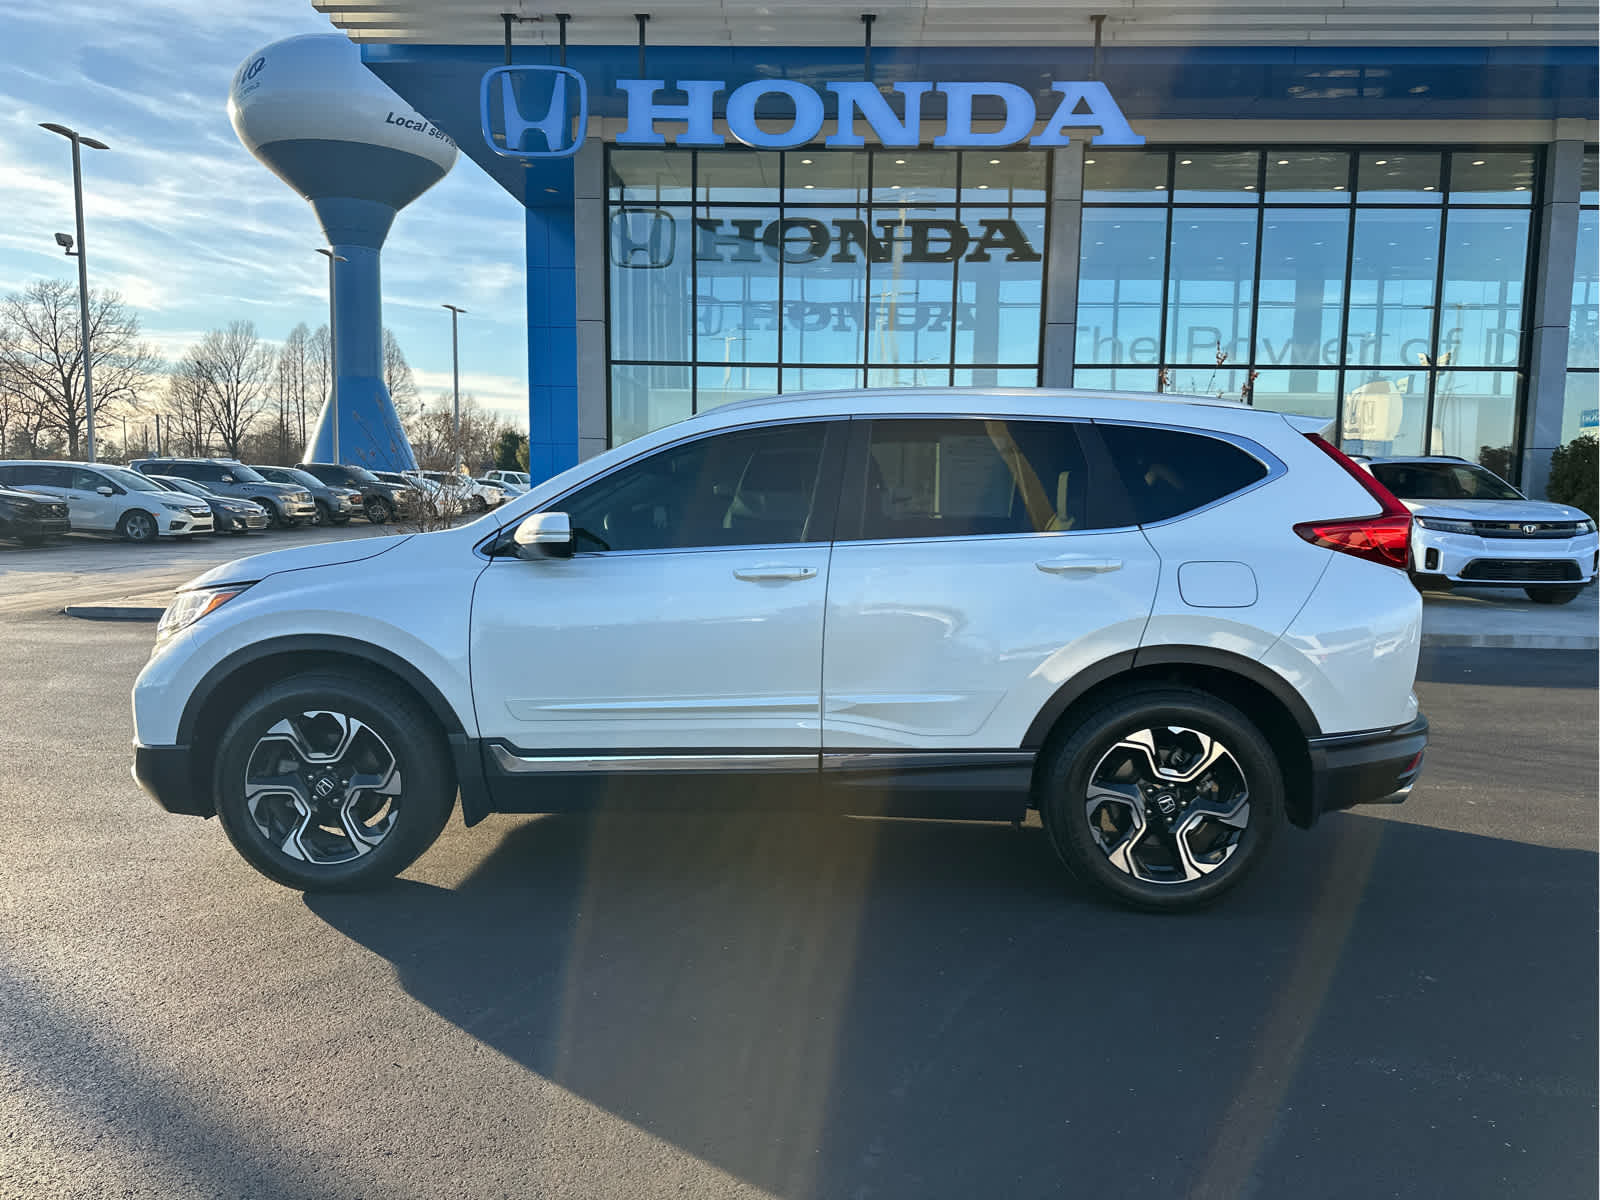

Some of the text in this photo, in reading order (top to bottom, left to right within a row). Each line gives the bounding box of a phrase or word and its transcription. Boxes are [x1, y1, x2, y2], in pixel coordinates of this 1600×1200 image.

[385, 111, 428, 133] Local
[615, 79, 1146, 149] HONDA
[694, 218, 1042, 263] HONDA
